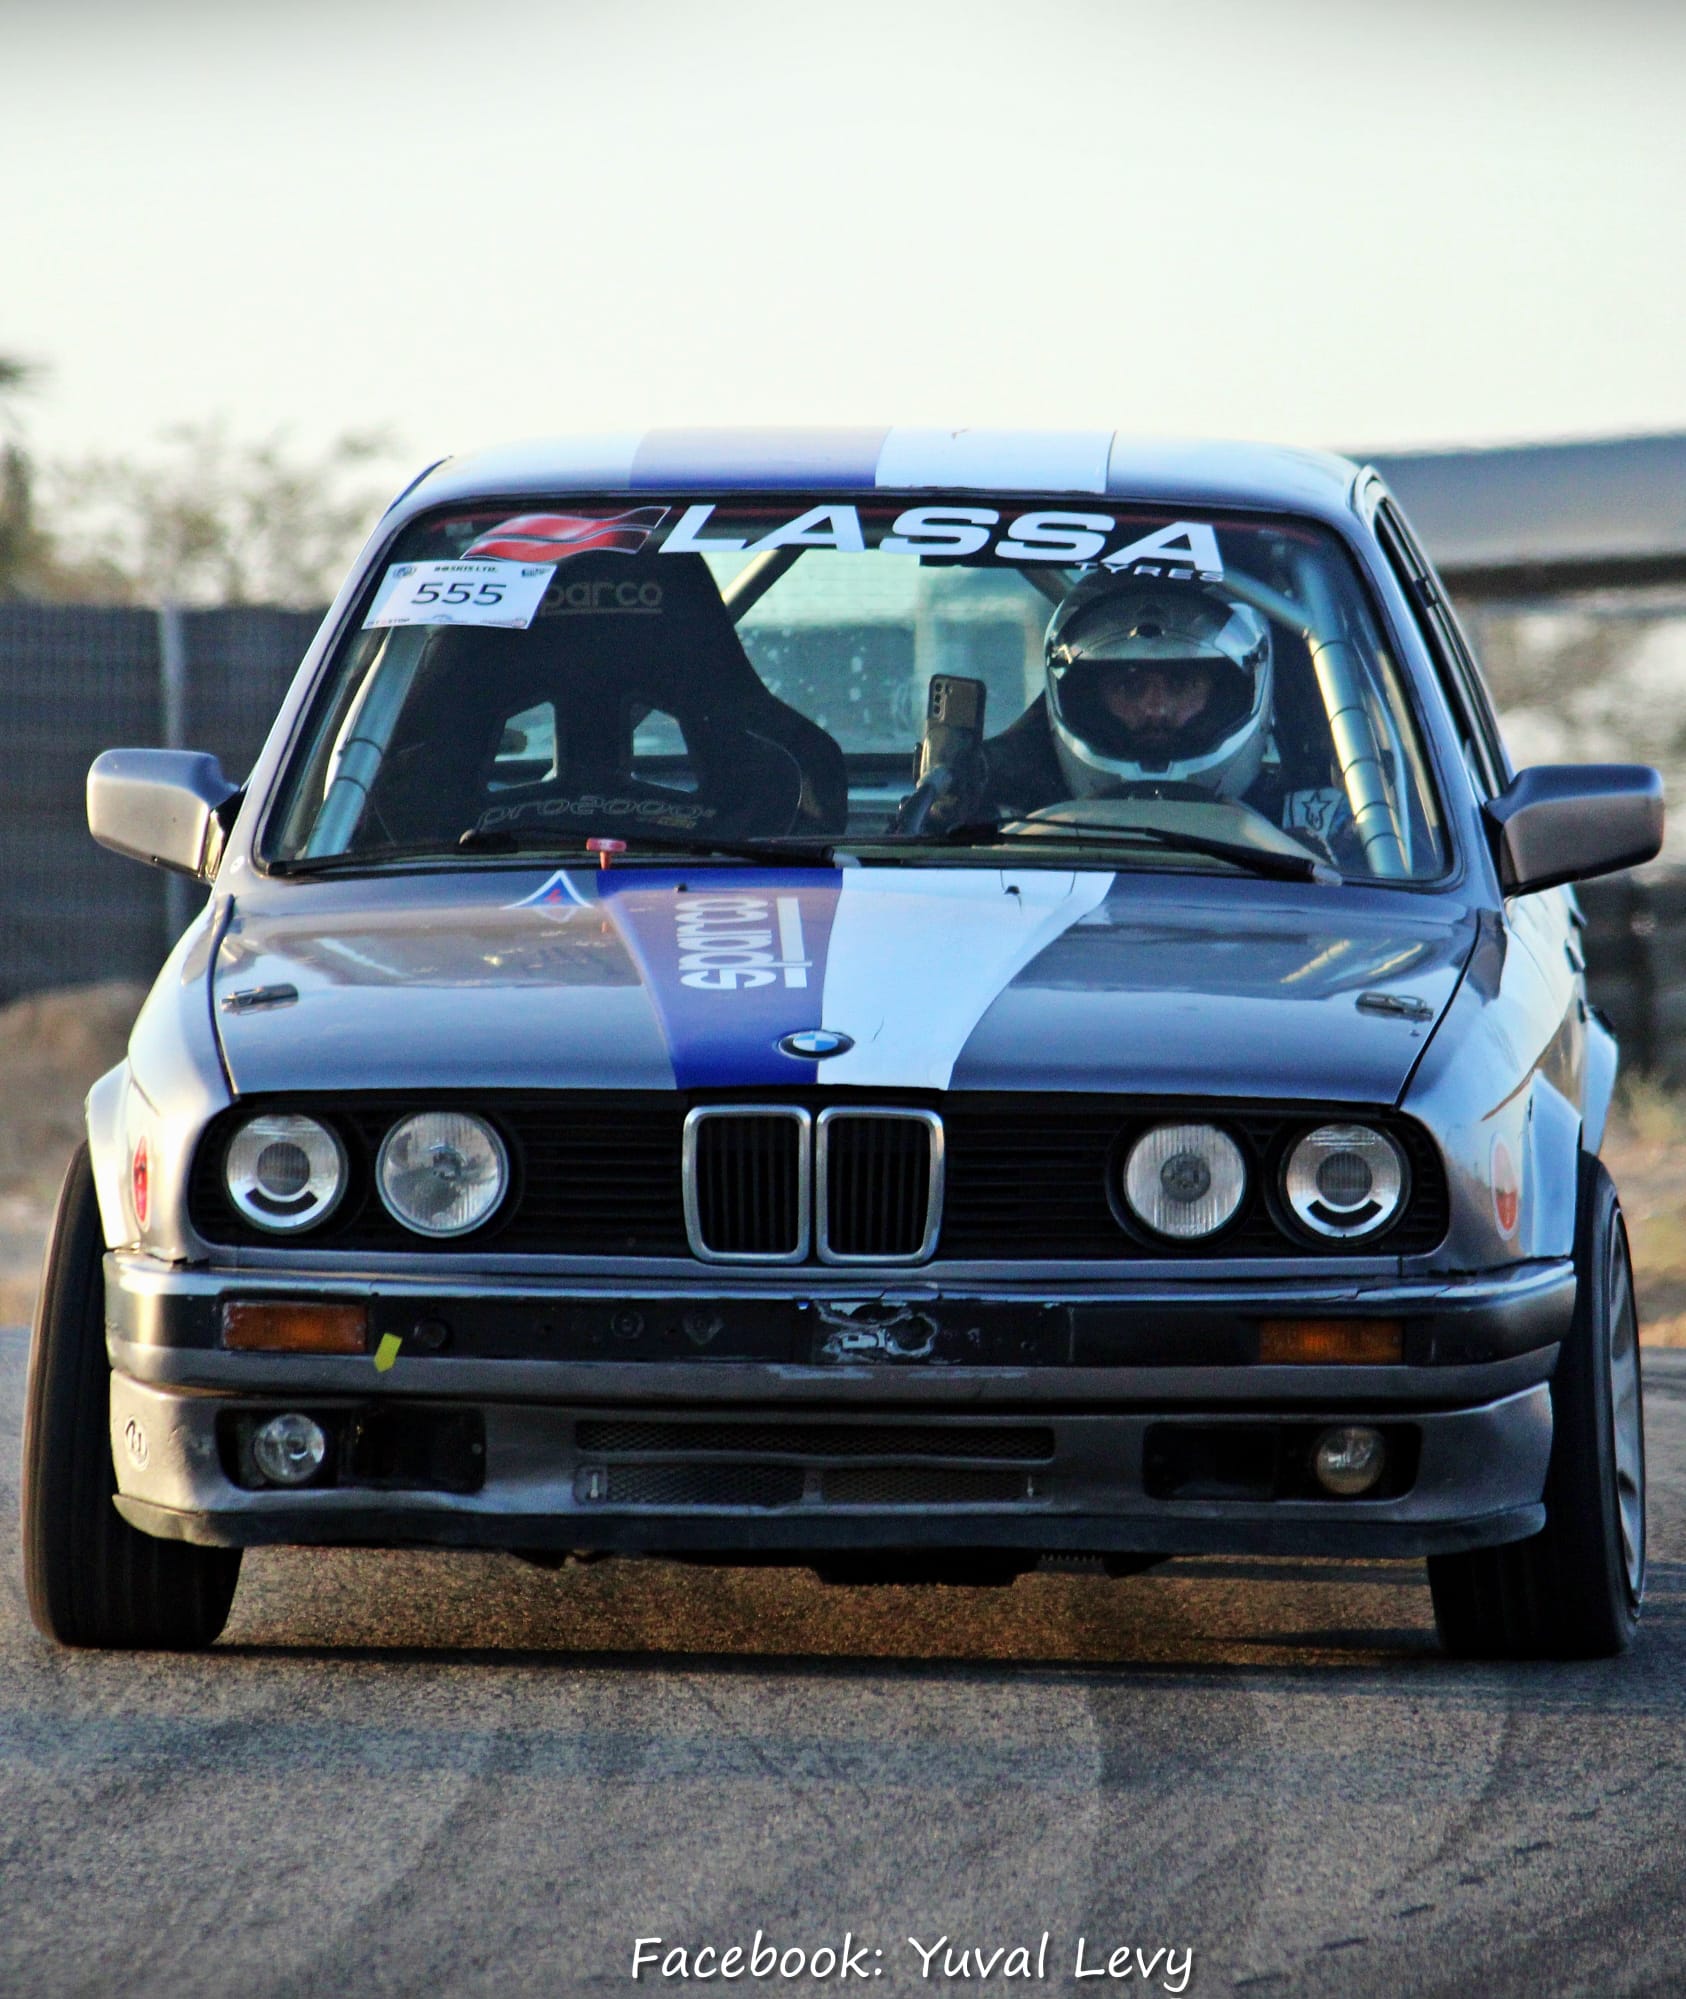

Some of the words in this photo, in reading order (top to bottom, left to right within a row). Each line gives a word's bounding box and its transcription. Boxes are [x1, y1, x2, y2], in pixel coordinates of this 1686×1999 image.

[658, 505, 1224, 572] LASSA
[1075, 561, 1224, 582] TYRES
[411, 582, 507, 606] 555
[539, 582, 663, 614] parco
[674, 897, 813, 990] sparco
